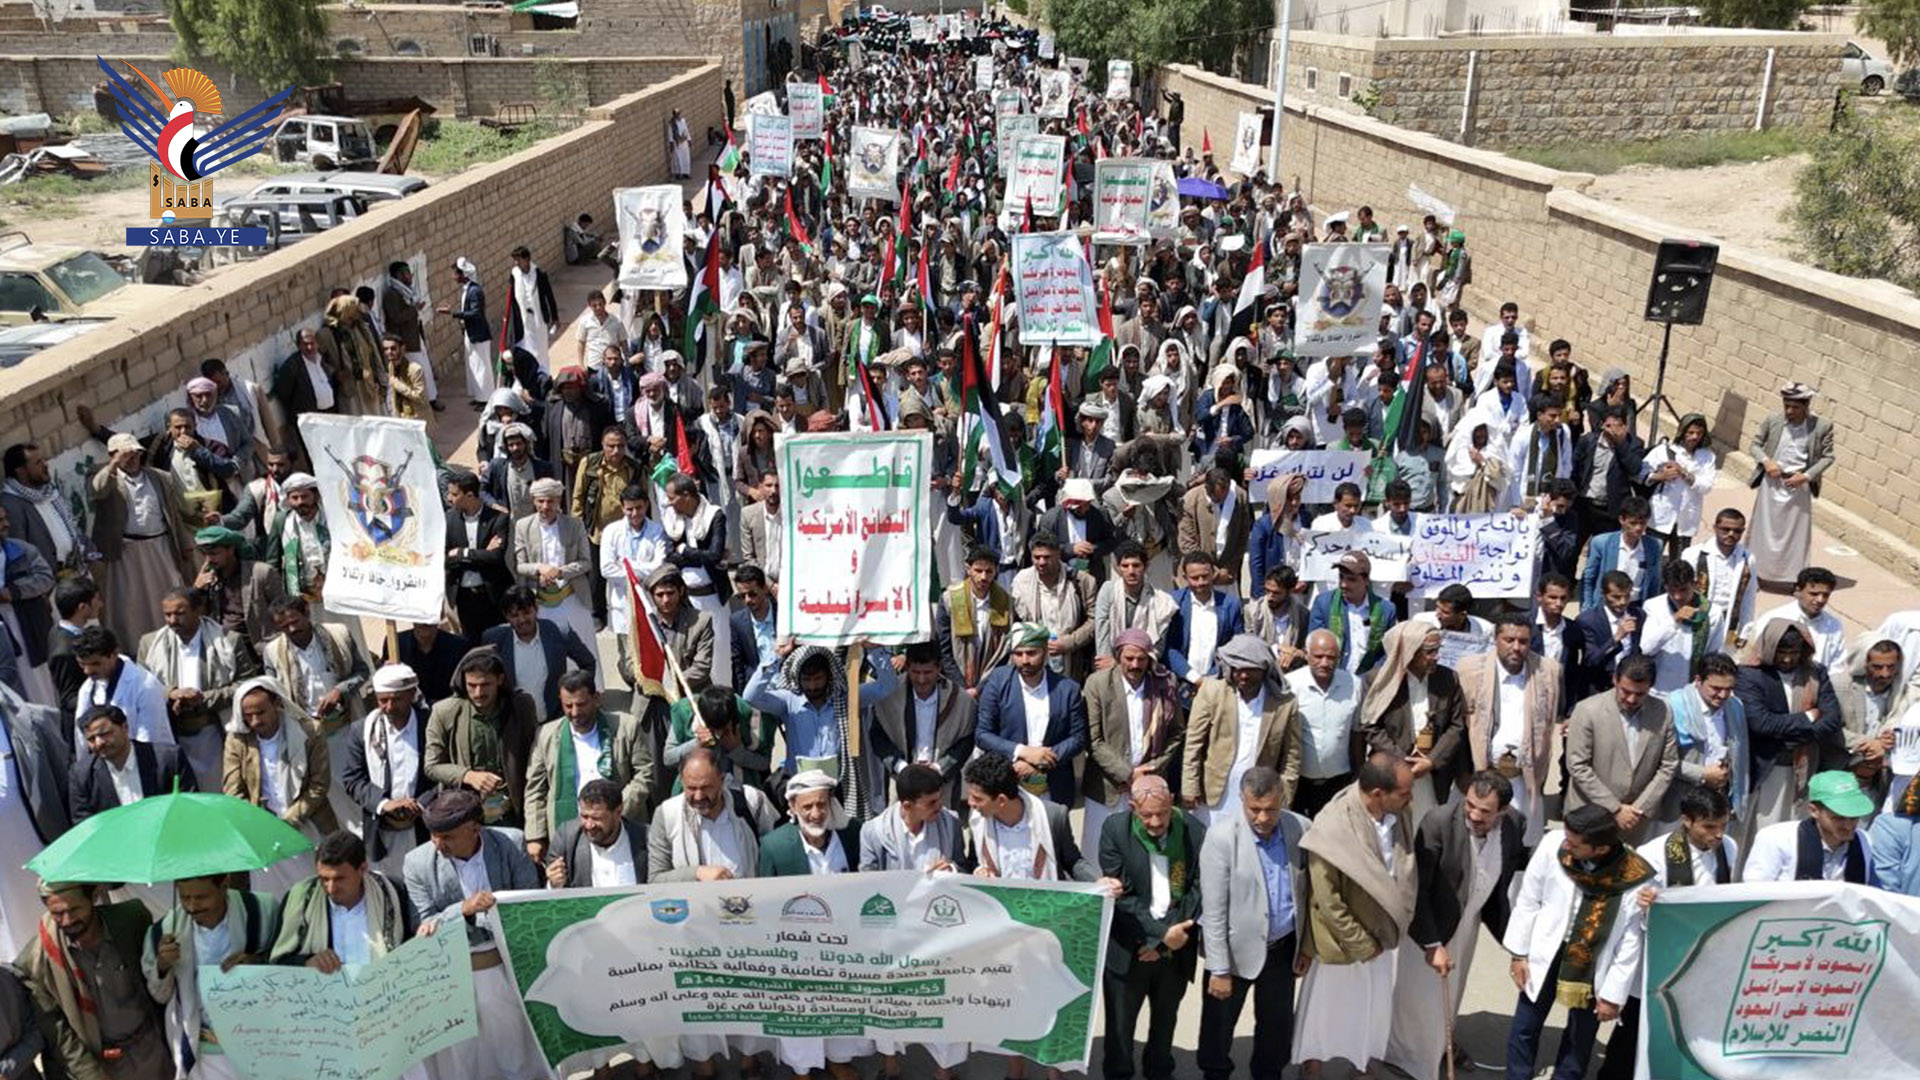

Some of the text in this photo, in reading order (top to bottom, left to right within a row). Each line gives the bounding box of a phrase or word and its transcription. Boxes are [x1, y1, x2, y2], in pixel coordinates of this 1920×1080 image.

[796, 455, 912, 498] قاطعوا
[1332, 461, 1354, 481] لن
[797, 504, 910, 541] البضائع الأمريكية
[776, 930, 811, 943] شعار
[817, 933, 848, 945] تحت
[1755, 923, 1881, 954] الله أكبر
[670, 946, 721, 959] قضيتنا
[727, 946, 799, 962] وفلسطين
[819, 949, 865, 965] قدوتنا
[869, 949, 893, 966] الله
[608, 958, 1013, 980] تقيم جامعة صعدة مسيرة تضامنية وفعالية خطابية بمناسبة
[899, 955, 941, 969] رسول
[1817, 957, 1873, 975] الموت
[713, 990, 739, 999] عليه
[849, 983, 893, 994] المولد
[1809, 979, 1862, 995] الموت
[743, 991, 765, 1000] الله
[608, 997, 647, 1013] وسلم
[706, 1000, 728, 1012] غزة
[731, 1001, 755, 1012] في
[810, 1003, 866, 1015] ومساندة
[1735, 1000, 1855, 1020] اللعنة على اليهود
[1791, 1022, 1847, 1046] النصر
